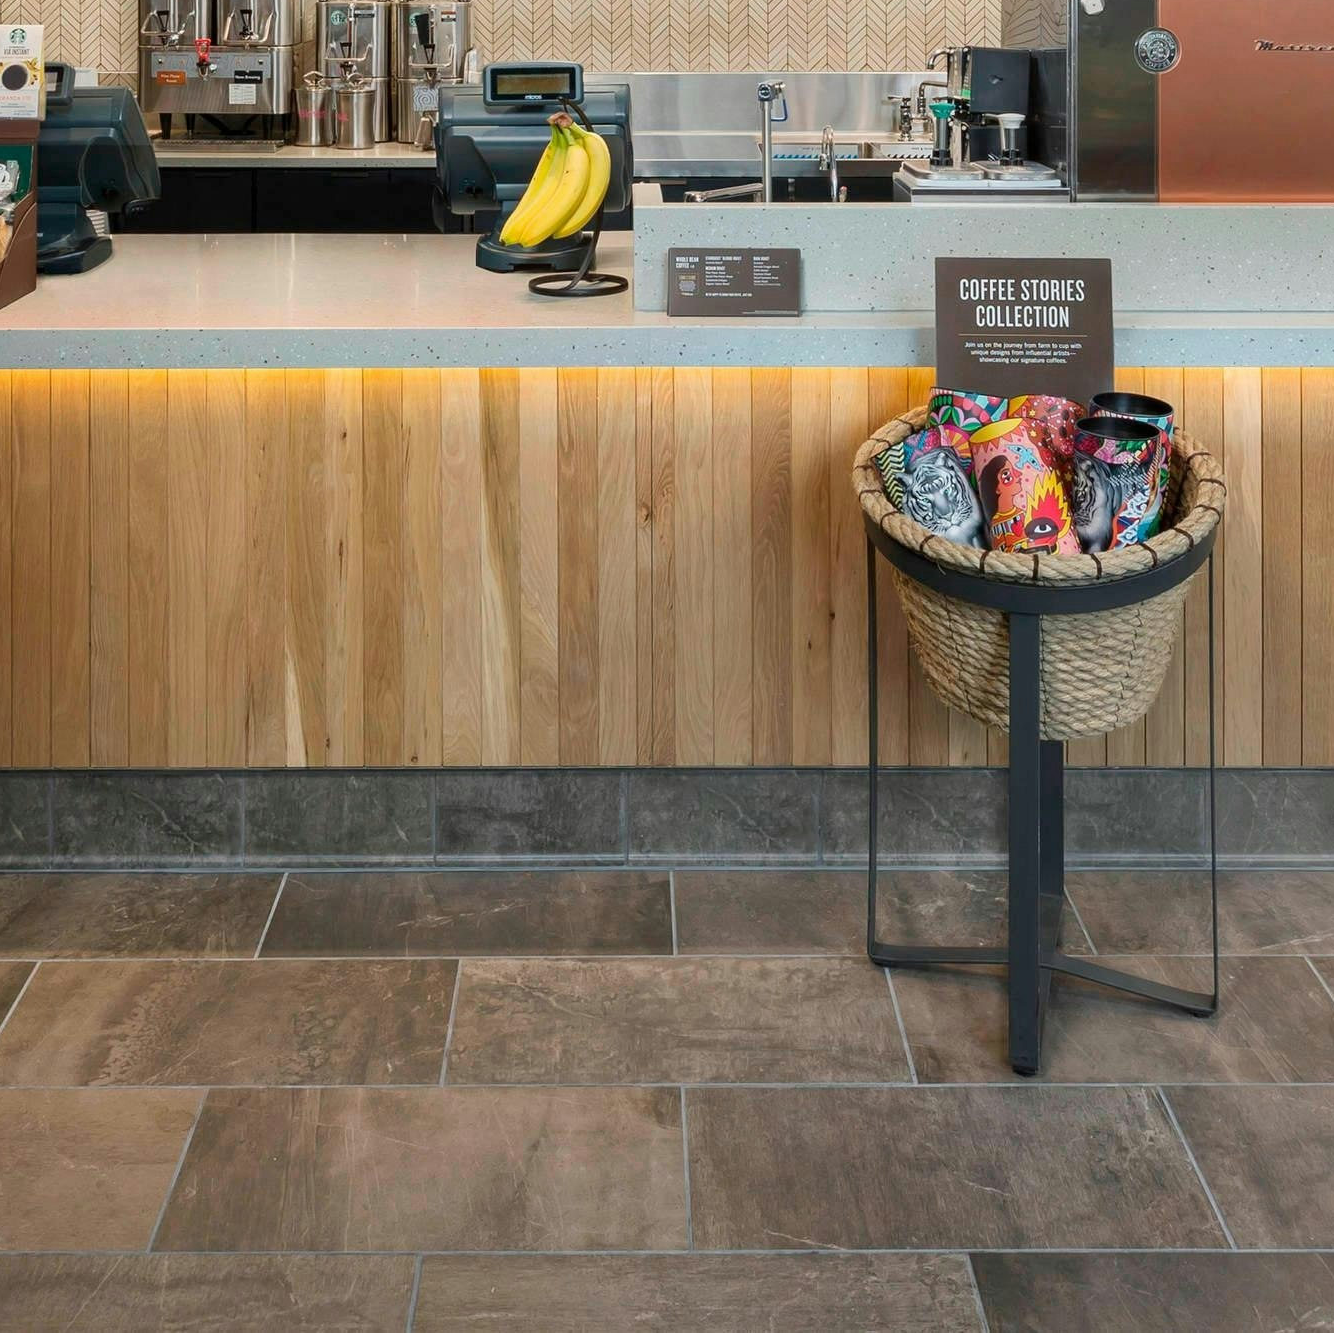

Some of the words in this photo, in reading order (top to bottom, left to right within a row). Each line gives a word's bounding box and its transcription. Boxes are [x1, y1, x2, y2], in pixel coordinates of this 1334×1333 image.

[960, 279, 1015, 300] COFFEE
[1021, 279, 1085, 301] STORIES
[976, 305, 1069, 327] COLLECTION
[1003, 343, 1023, 351] journey
